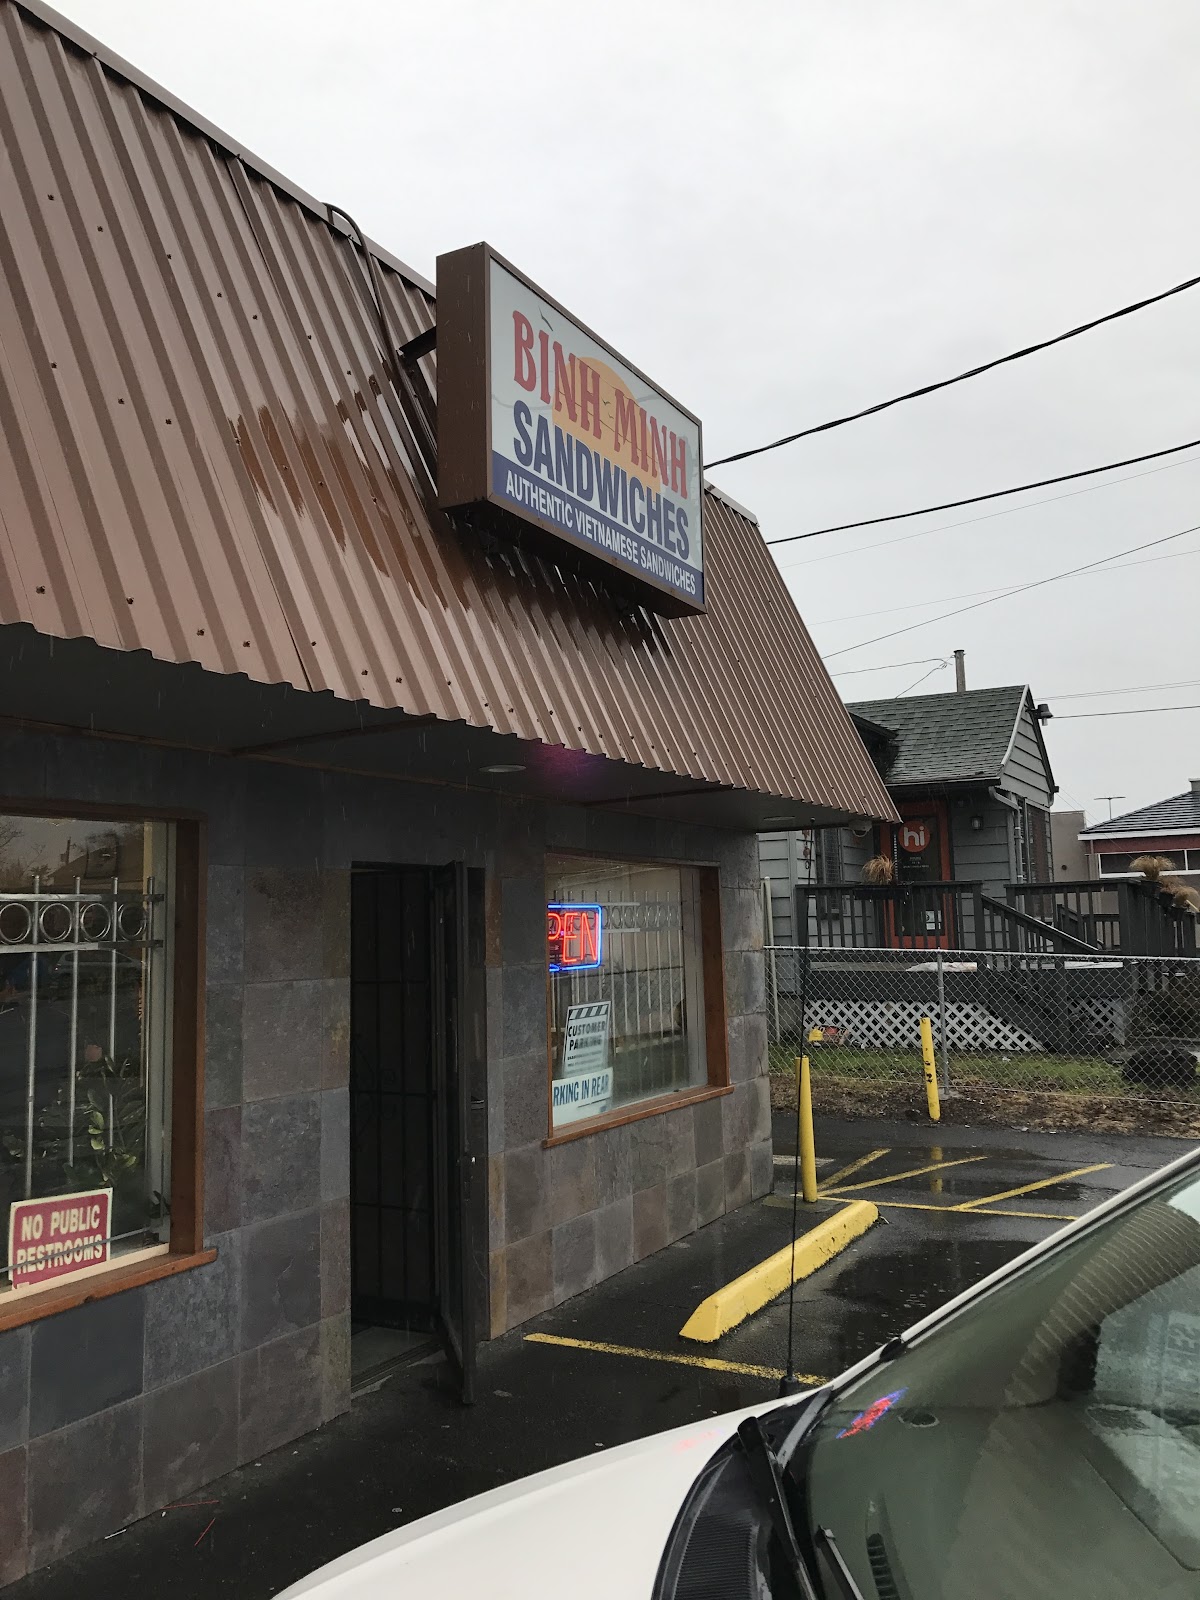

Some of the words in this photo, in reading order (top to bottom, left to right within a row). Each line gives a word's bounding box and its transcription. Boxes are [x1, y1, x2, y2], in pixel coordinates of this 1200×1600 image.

[512, 309, 602, 440] BINH
[614, 388, 689, 499] MINH
[513, 400, 690, 561] SANDWICHES
[505, 469, 573, 529] AUTHENTIC
[574, 507, 639, 565] VIETNAMESE
[640, 545, 696, 596] SANDWICHES
[904, 826, 925, 846] hi
[548, 912, 598, 963] PEN
[567, 1020, 606, 1037] CUSTOMER
[553, 1081, 580, 1107] RKING
[581, 1078, 590, 1100] IN
[591, 1074, 609, 1097] REAR
[21, 1213, 44, 1242] NO
[49, 1204, 101, 1237] PUBLIC
[16, 1233, 103, 1275] RESTROOMS
